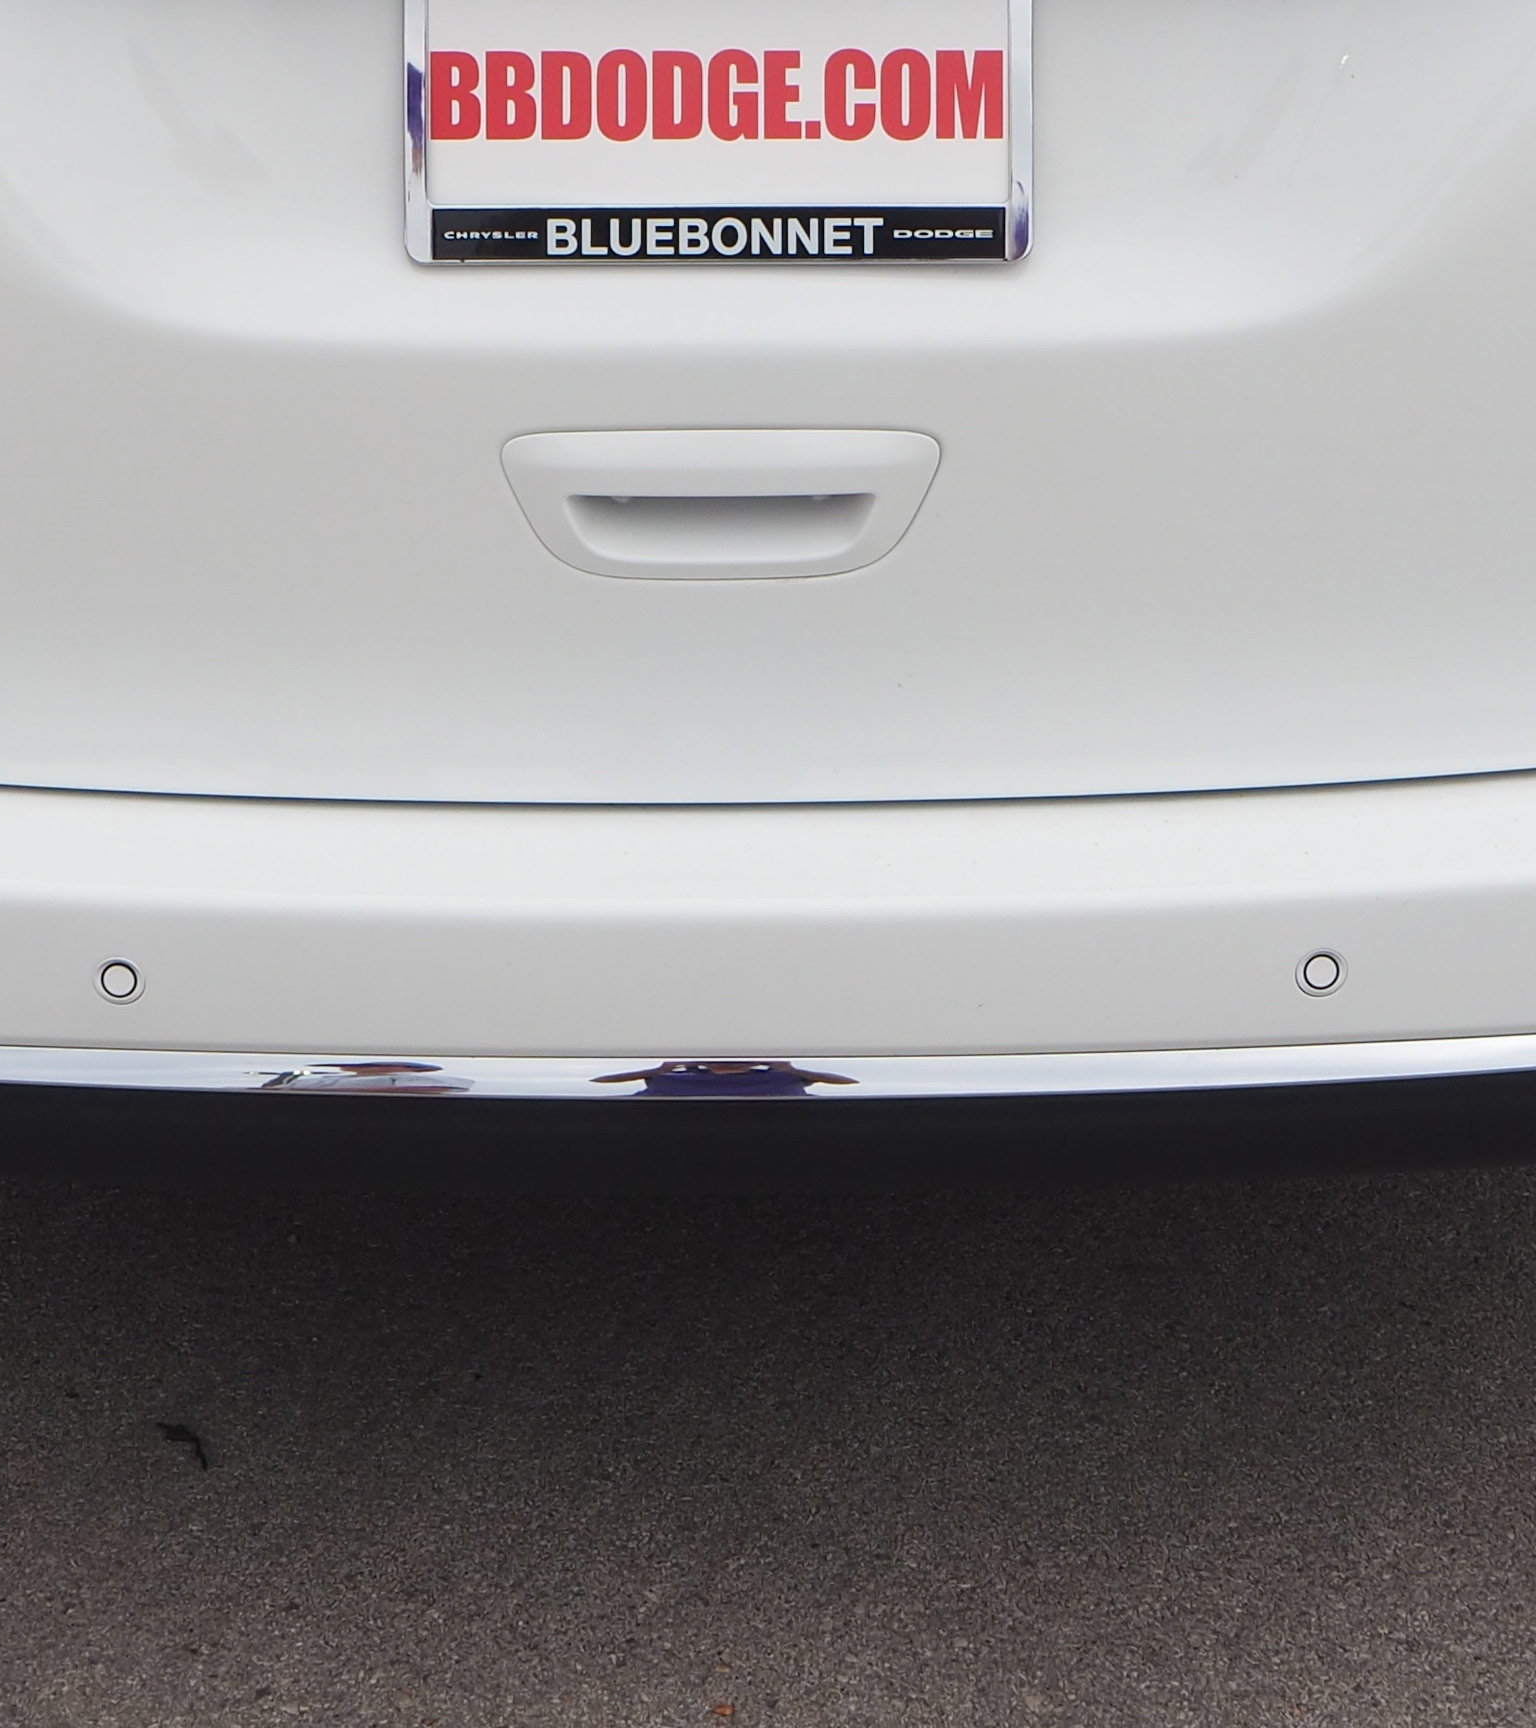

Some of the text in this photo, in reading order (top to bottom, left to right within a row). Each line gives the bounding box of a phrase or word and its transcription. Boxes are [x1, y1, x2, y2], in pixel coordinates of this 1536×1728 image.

[429, 48, 1004, 141] BBDODGE.COM
[443, 217, 994, 256] CHRYSLER BLUEBONNET DODGE
